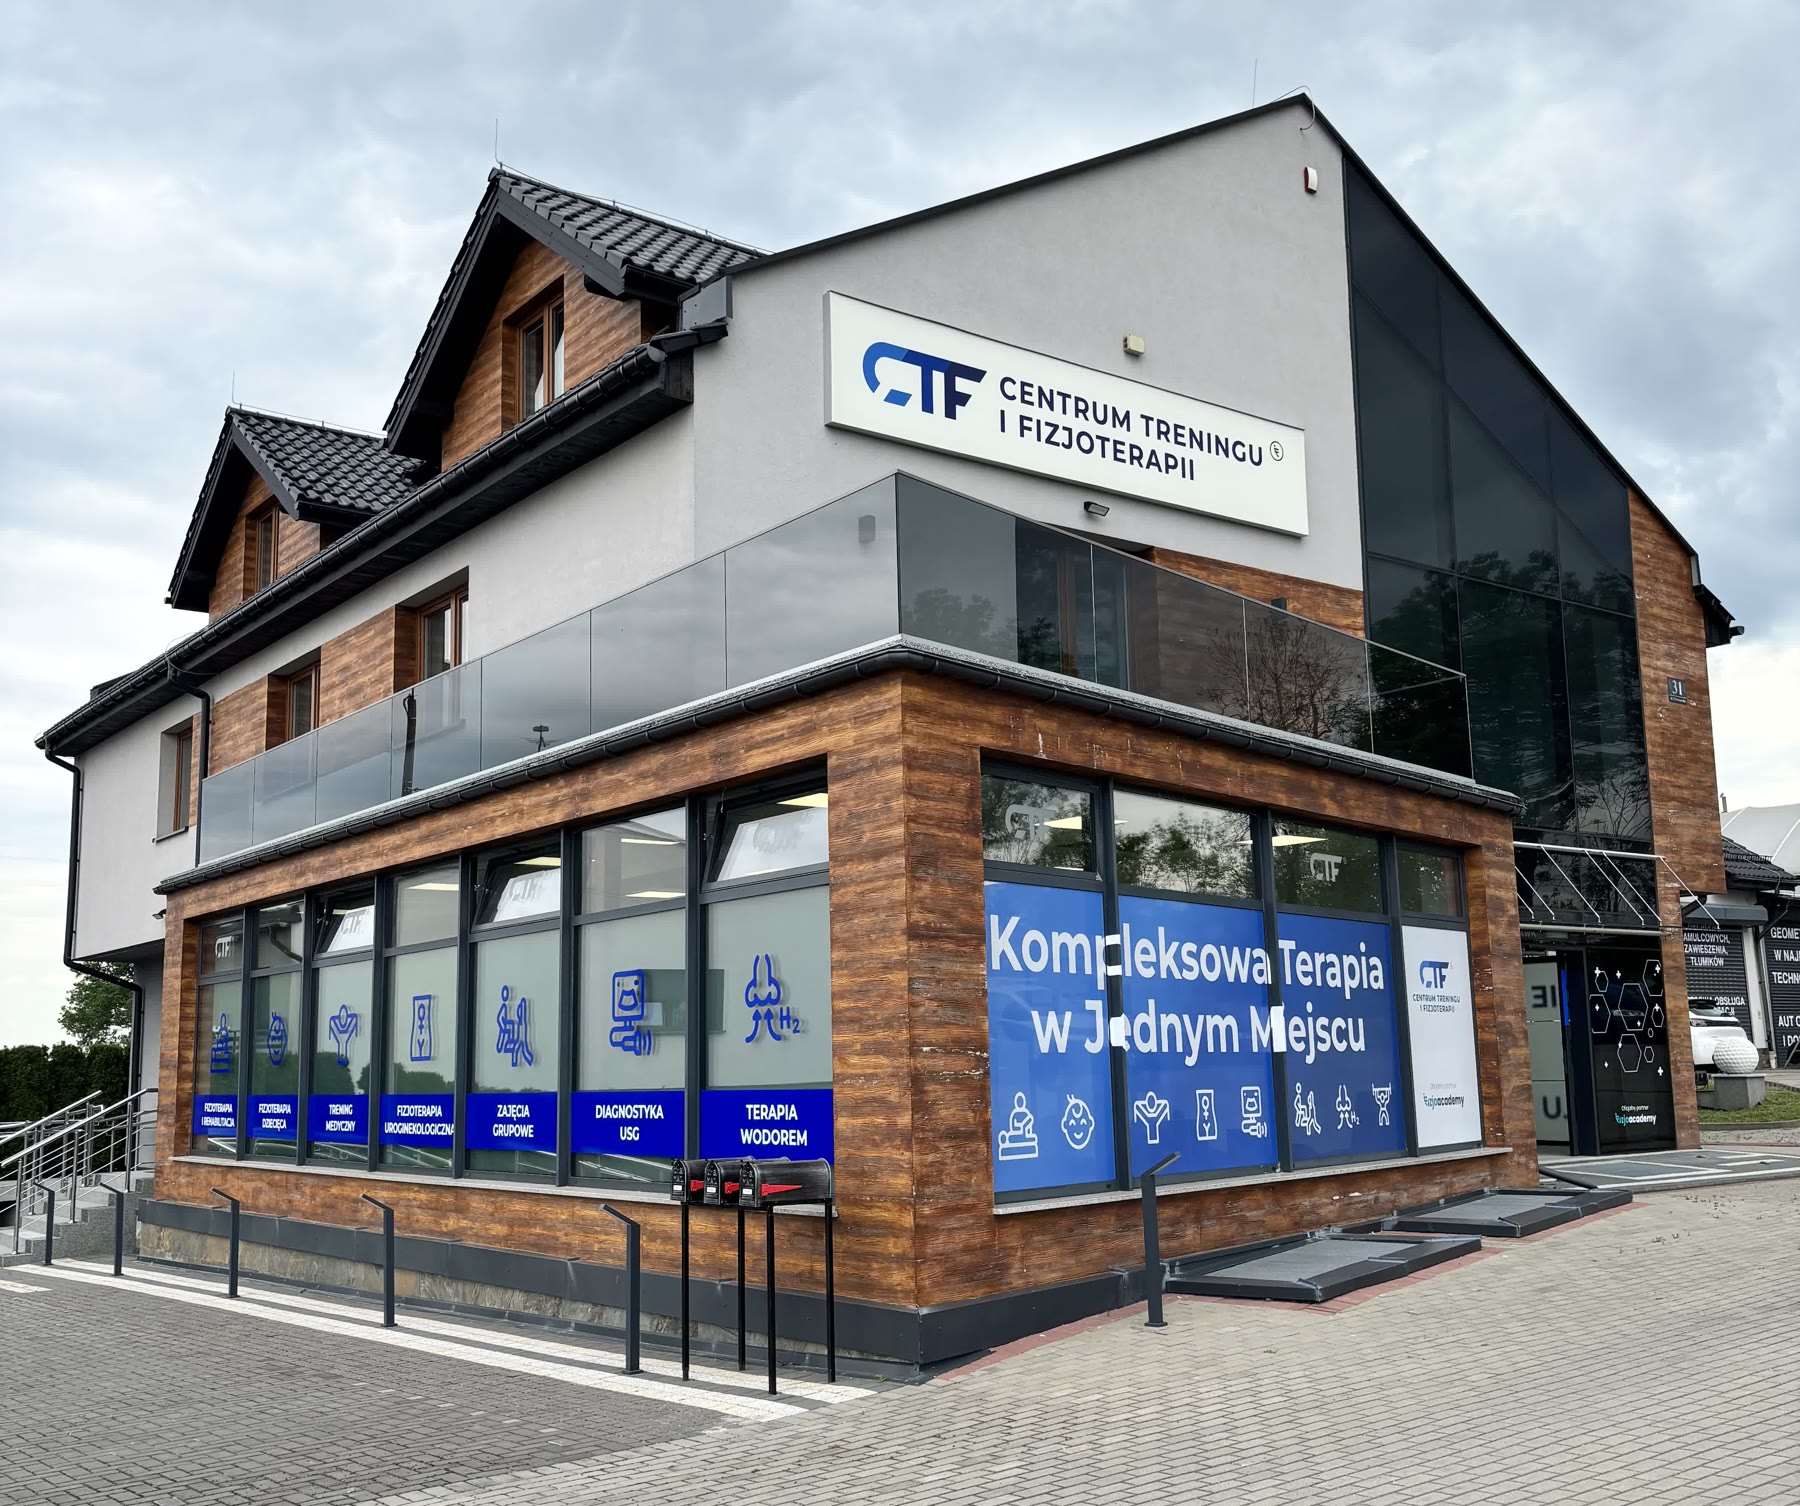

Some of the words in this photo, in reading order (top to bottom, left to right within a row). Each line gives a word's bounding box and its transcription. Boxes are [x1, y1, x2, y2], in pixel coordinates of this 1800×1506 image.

[1000, 376, 1131, 433] CENTRUM
[1140, 414, 1264, 467] TRENINGU
[1000, 409, 1006, 433] I
[1019, 414, 1196, 481] FIZJOTERAPII
[1671, 680, 1683, 696] 31
[990, 914, 1272, 991] Kompleksowa
[1278, 939, 1385, 1000] Terapia
[1773, 949, 1782, 961] W
[1783, 949, 1800, 962] NAJ
[1412, 993, 1436, 1002] CENTRUM
[1437, 994, 1461, 1003] TRENINGU
[1030, 1010, 1072, 1054] w
[1084, 999, 1240, 1067] Jednym
[204, 1102, 234, 1114] FIZJOTERAPIA
[258, 1103, 292, 1115] FIZJOTERAPIA
[328, 1104, 353, 1116] TRENING
[396, 1105, 443, 1118] FIZJOTERAPIA
[496, 1104, 530, 1121] ZAJĘCIA
[595, 1104, 664, 1120] DIAGNOSTYKA
[745, 1104, 799, 1121] TERAPIA
[262, 1117, 287, 1132] DZIECIĘCA
[325, 1120, 356, 1133] MEDYCZNY
[384, 1121, 455, 1136] UROGINEKOLOGICZNA
[492, 1123, 534, 1139] GRUPOWE
[619, 1126, 640, 1141] USG
[740, 1128, 808, 1147] WODOREM
